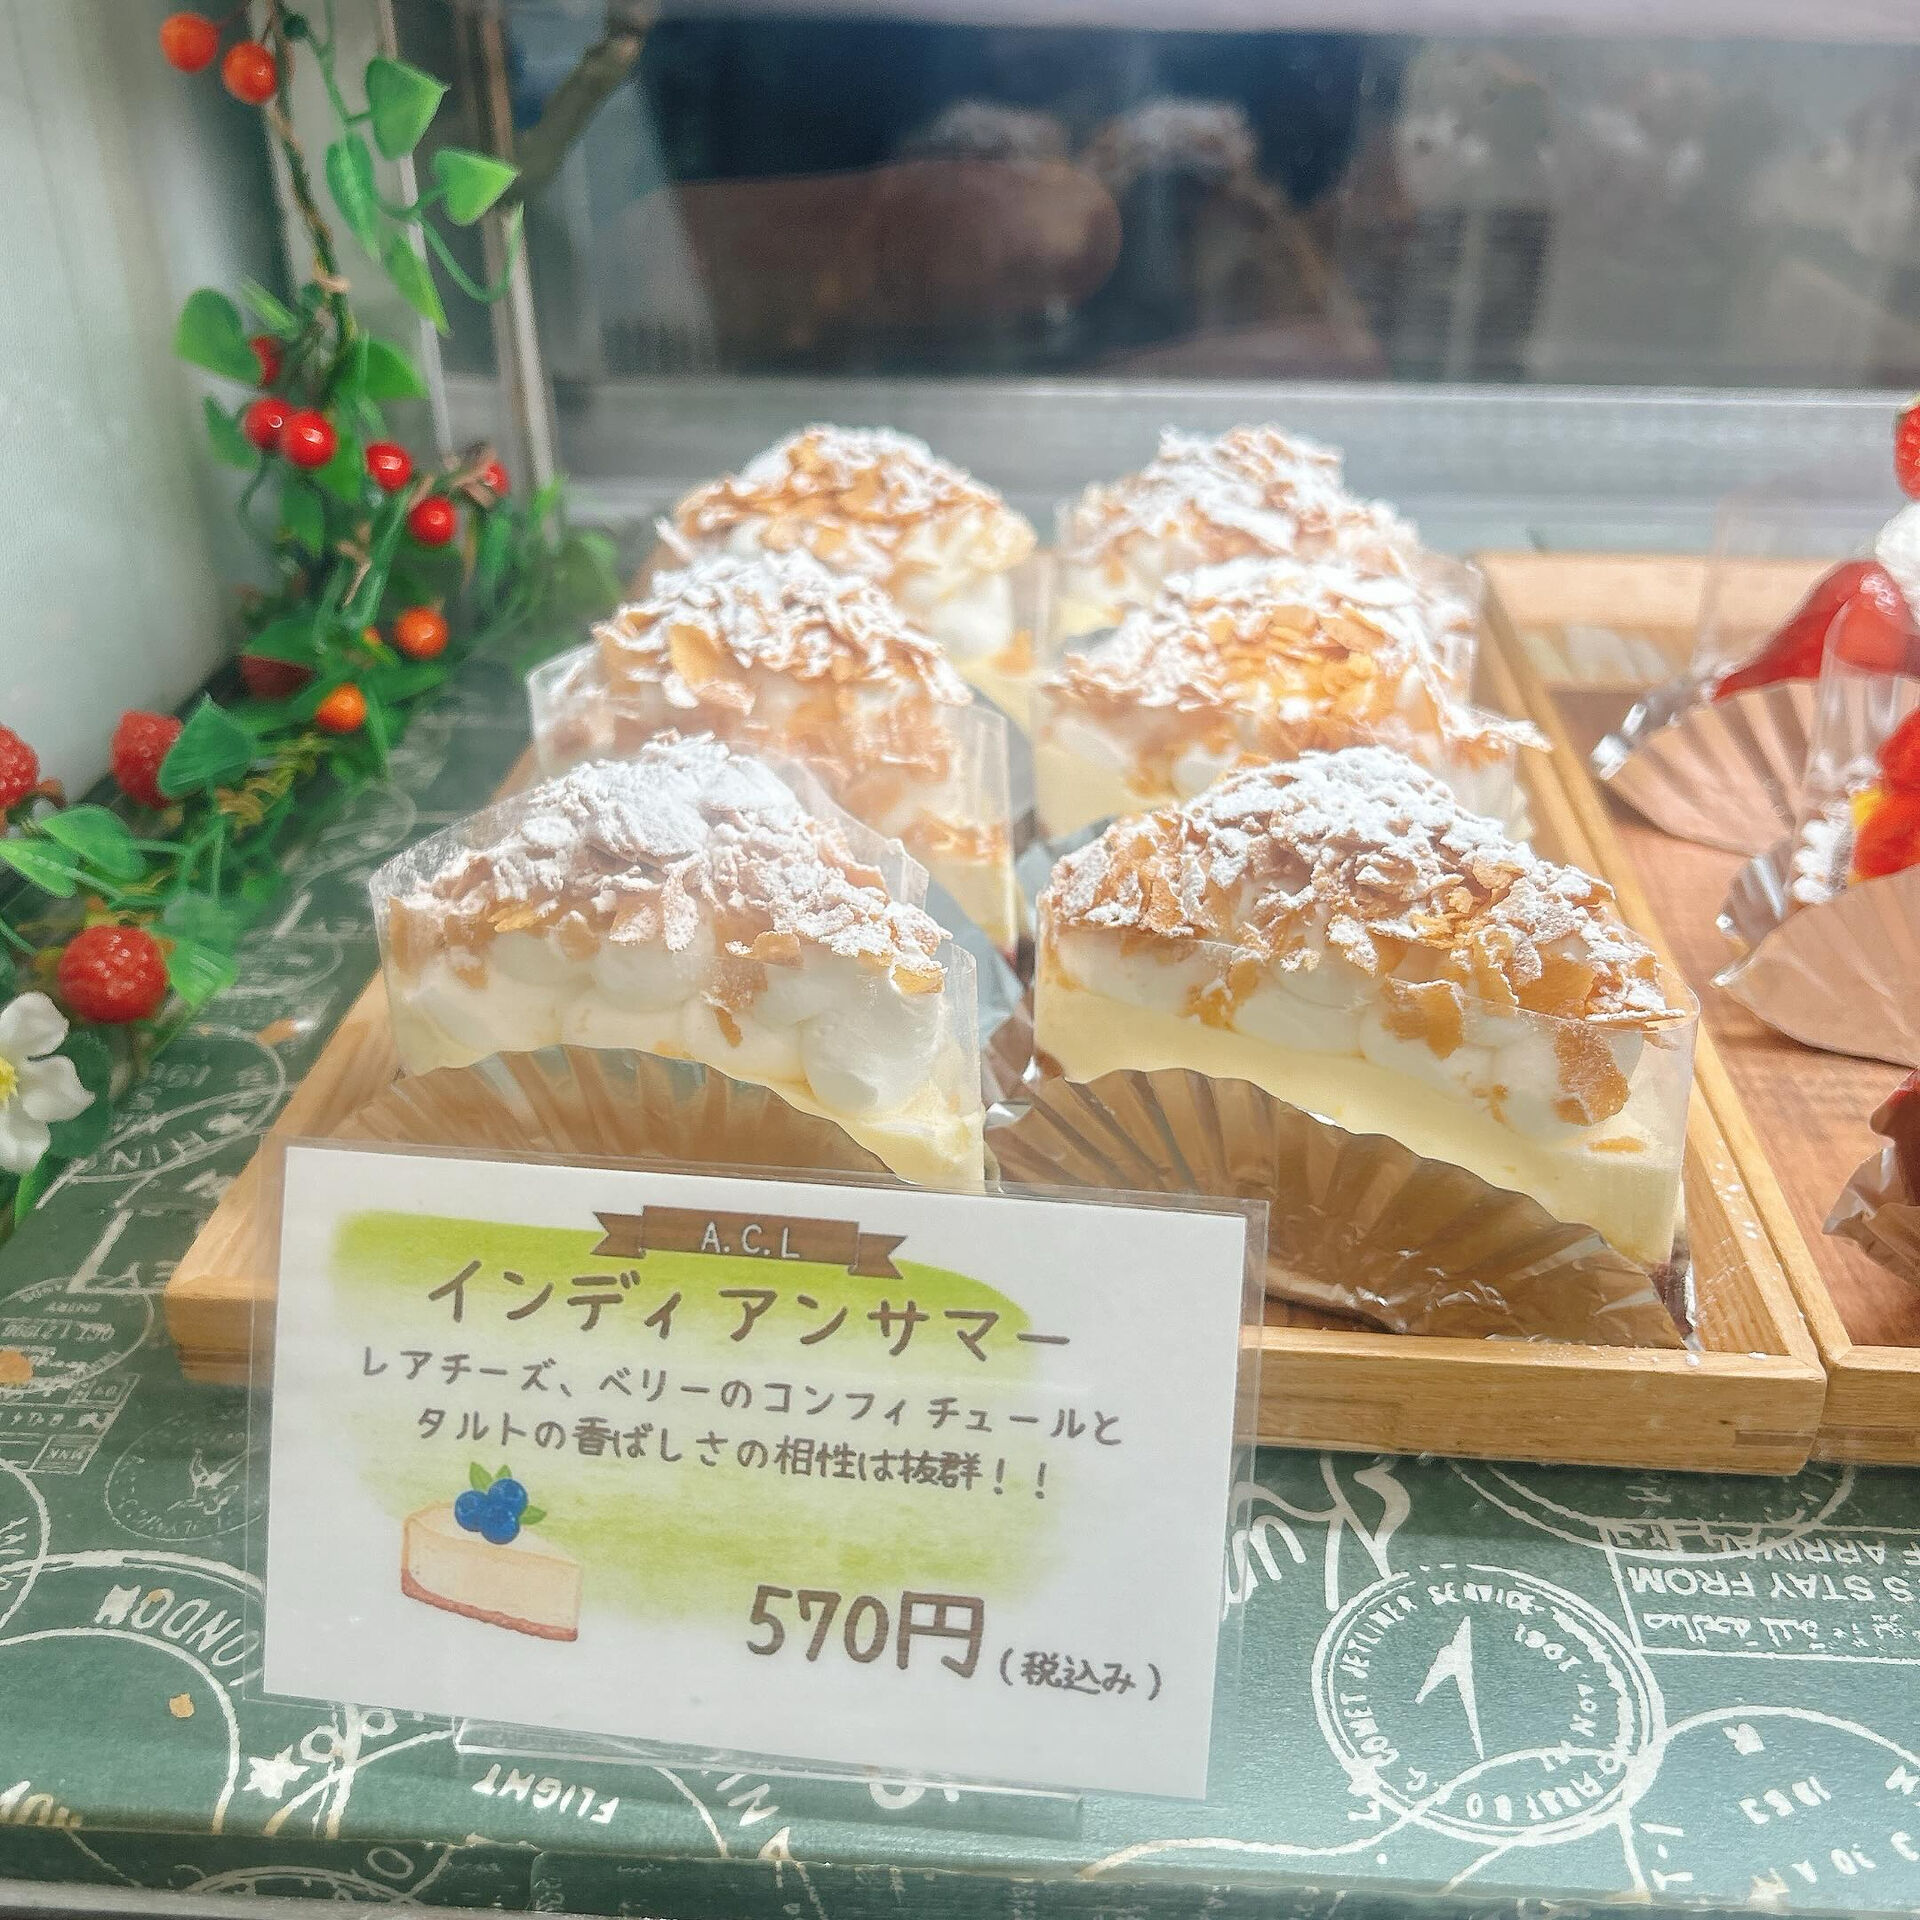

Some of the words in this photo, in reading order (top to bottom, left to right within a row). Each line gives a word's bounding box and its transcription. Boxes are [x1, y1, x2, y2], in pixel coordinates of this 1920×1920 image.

[700, 1221, 801, 1261] A.C.L
[428, 1259, 1070, 1361] インディアンサマー
[363, 1346, 1123, 1445] レアチーズ、ベリーのコンフィチュールと
[1627, 1566, 1756, 1598] FROM
[1770, 1571, 1877, 1602] STAY
[747, 1584, 985, 1678] 570円
[471, 1763, 620, 1825] FLIGHT
